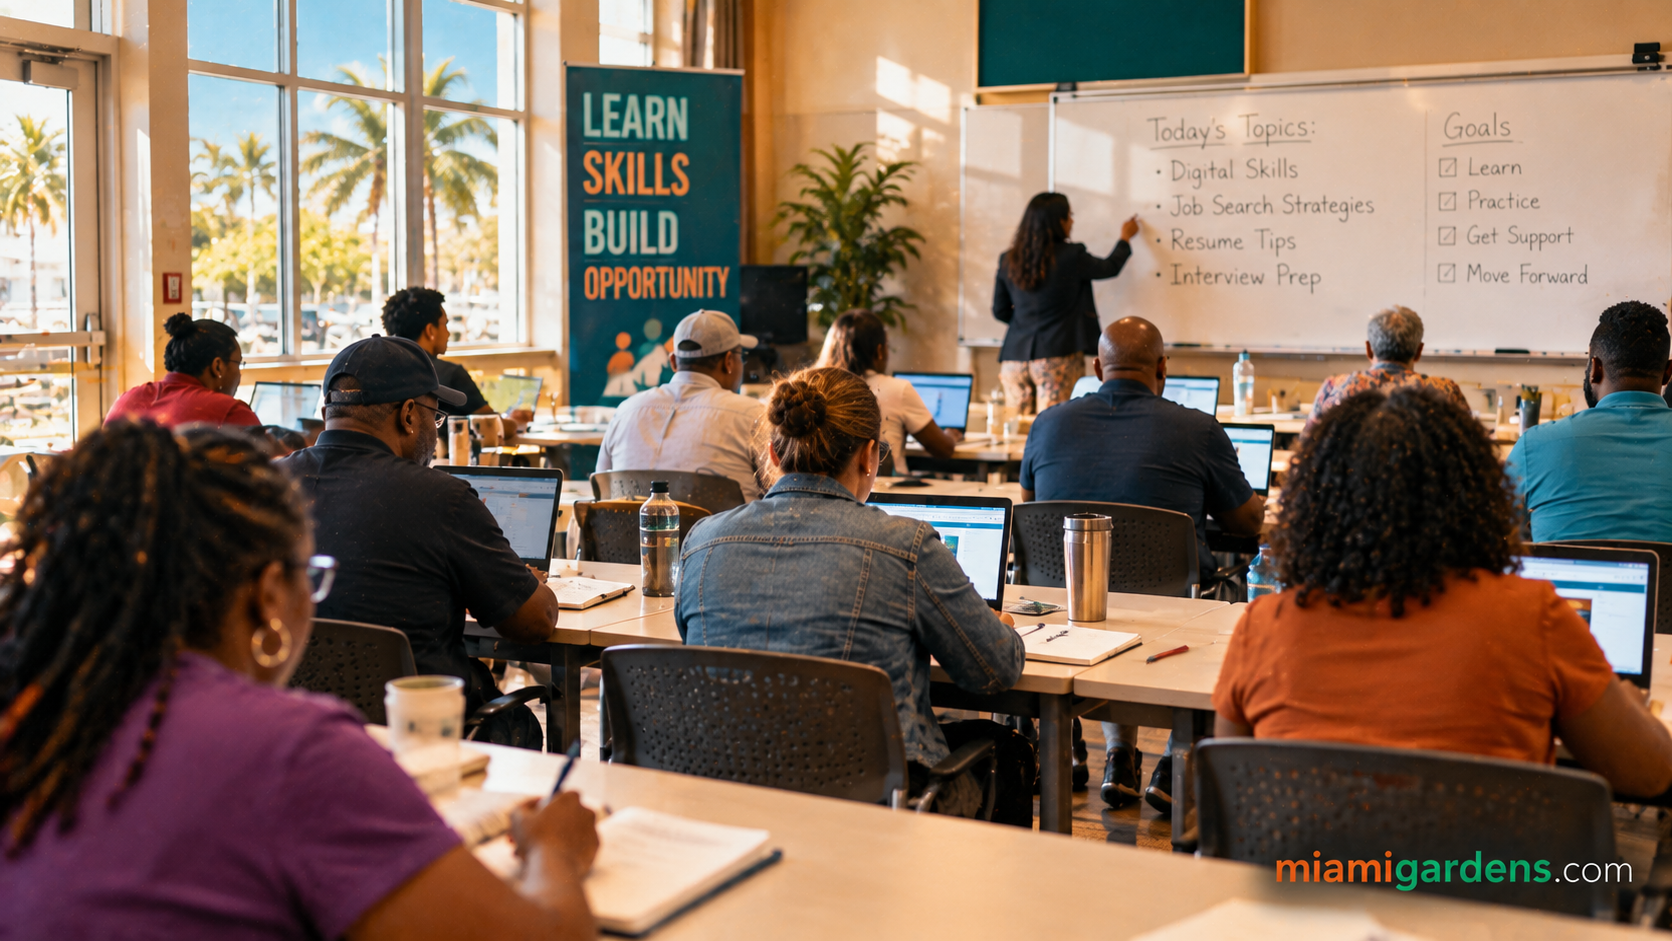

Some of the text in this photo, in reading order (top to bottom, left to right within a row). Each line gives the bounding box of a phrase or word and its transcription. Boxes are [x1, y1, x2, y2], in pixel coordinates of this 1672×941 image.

[582, 92, 689, 142] LEARN
[1146, 113, 1316, 149] Today's Topics:
[1443, 112, 1512, 139] Goals
[582, 150, 690, 197] SKILLS
[1170, 157, 1299, 190] Digital Skills
[1468, 156, 1523, 177] Learn
[1170, 193, 1375, 223] Job Search Strategies
[1468, 190, 1541, 211] Practice
[583, 209, 679, 256] BUILD
[1171, 227, 1297, 257] Resume Tips
[1466, 224, 1575, 252] Get Support
[584, 266, 730, 300] OPPORTUNITY
[1170, 263, 1322, 294] Interview Prep
[1467, 263, 1589, 286] Move Forward
